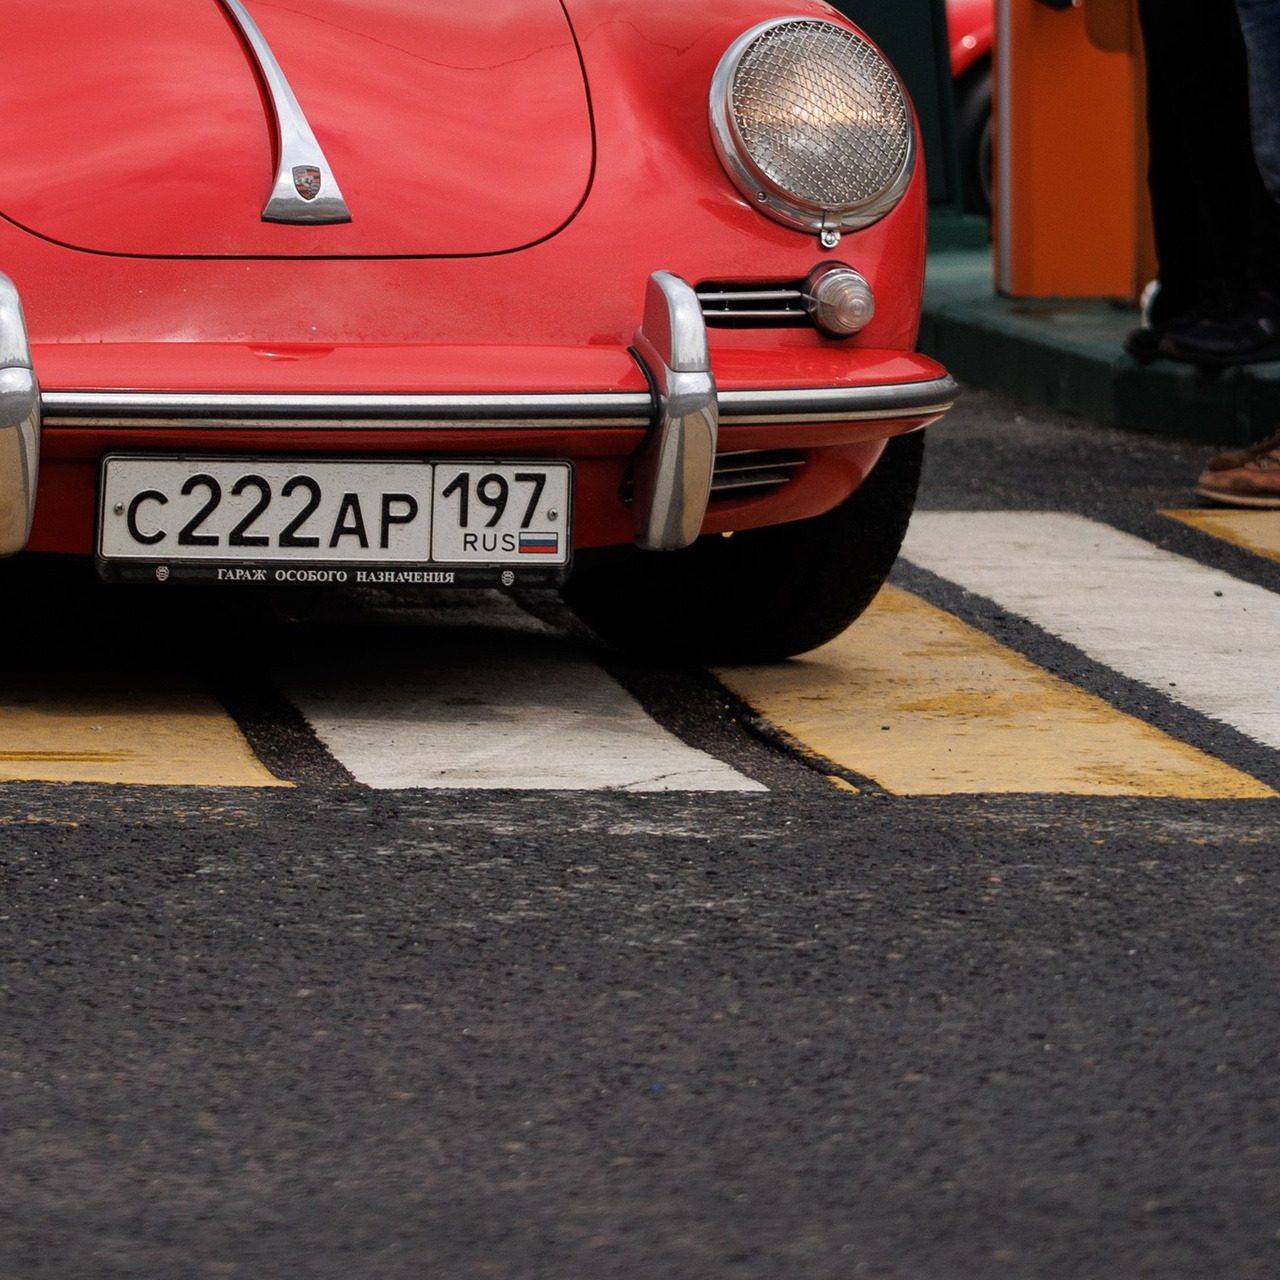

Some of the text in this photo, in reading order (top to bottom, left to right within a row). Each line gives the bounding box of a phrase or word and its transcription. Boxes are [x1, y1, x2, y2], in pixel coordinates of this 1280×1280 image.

[125, 471, 547, 550] С222АР 197
[463, 532, 516, 553] RUS
[216, 568, 455, 584] ГАРАЖ ОСОБОГО НАЗНАЧЕНИЯ
